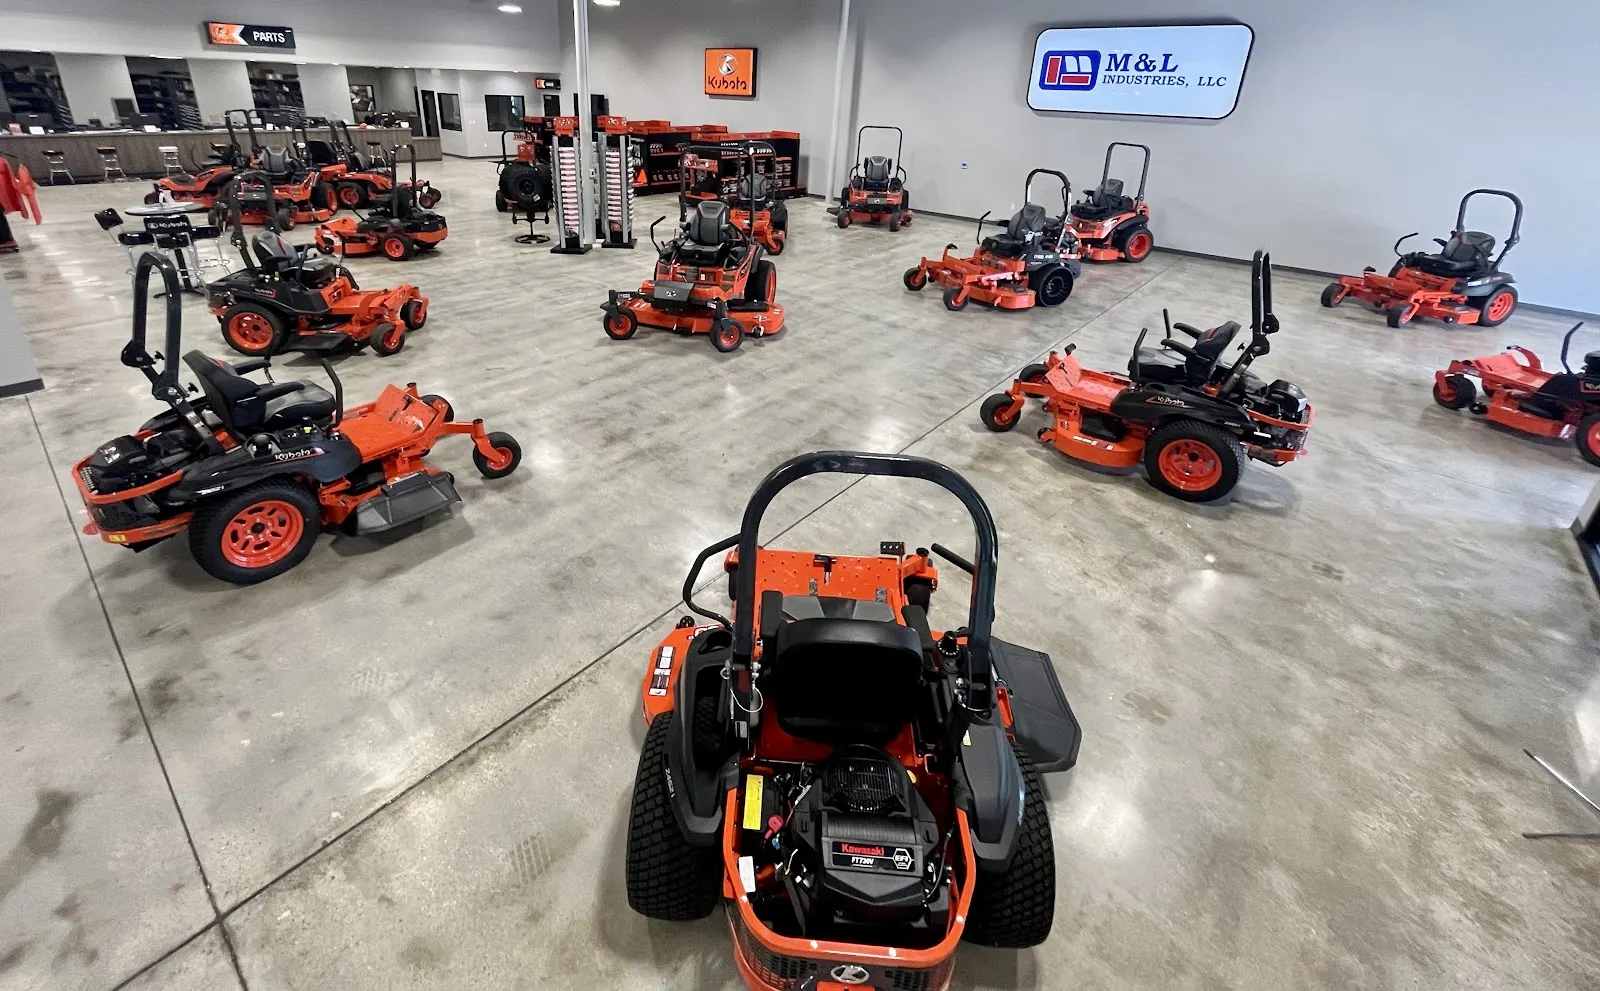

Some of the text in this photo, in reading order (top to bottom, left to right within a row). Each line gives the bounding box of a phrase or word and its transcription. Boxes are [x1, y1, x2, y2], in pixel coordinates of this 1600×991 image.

[252, 31, 285, 43] PARTS
[708, 76, 747, 90] Kubota
[1102, 74, 1227, 88] INDUSTRIES, LLC
[274, 449, 311, 460] Kubota
[841, 843, 885, 856] Kawasaki
